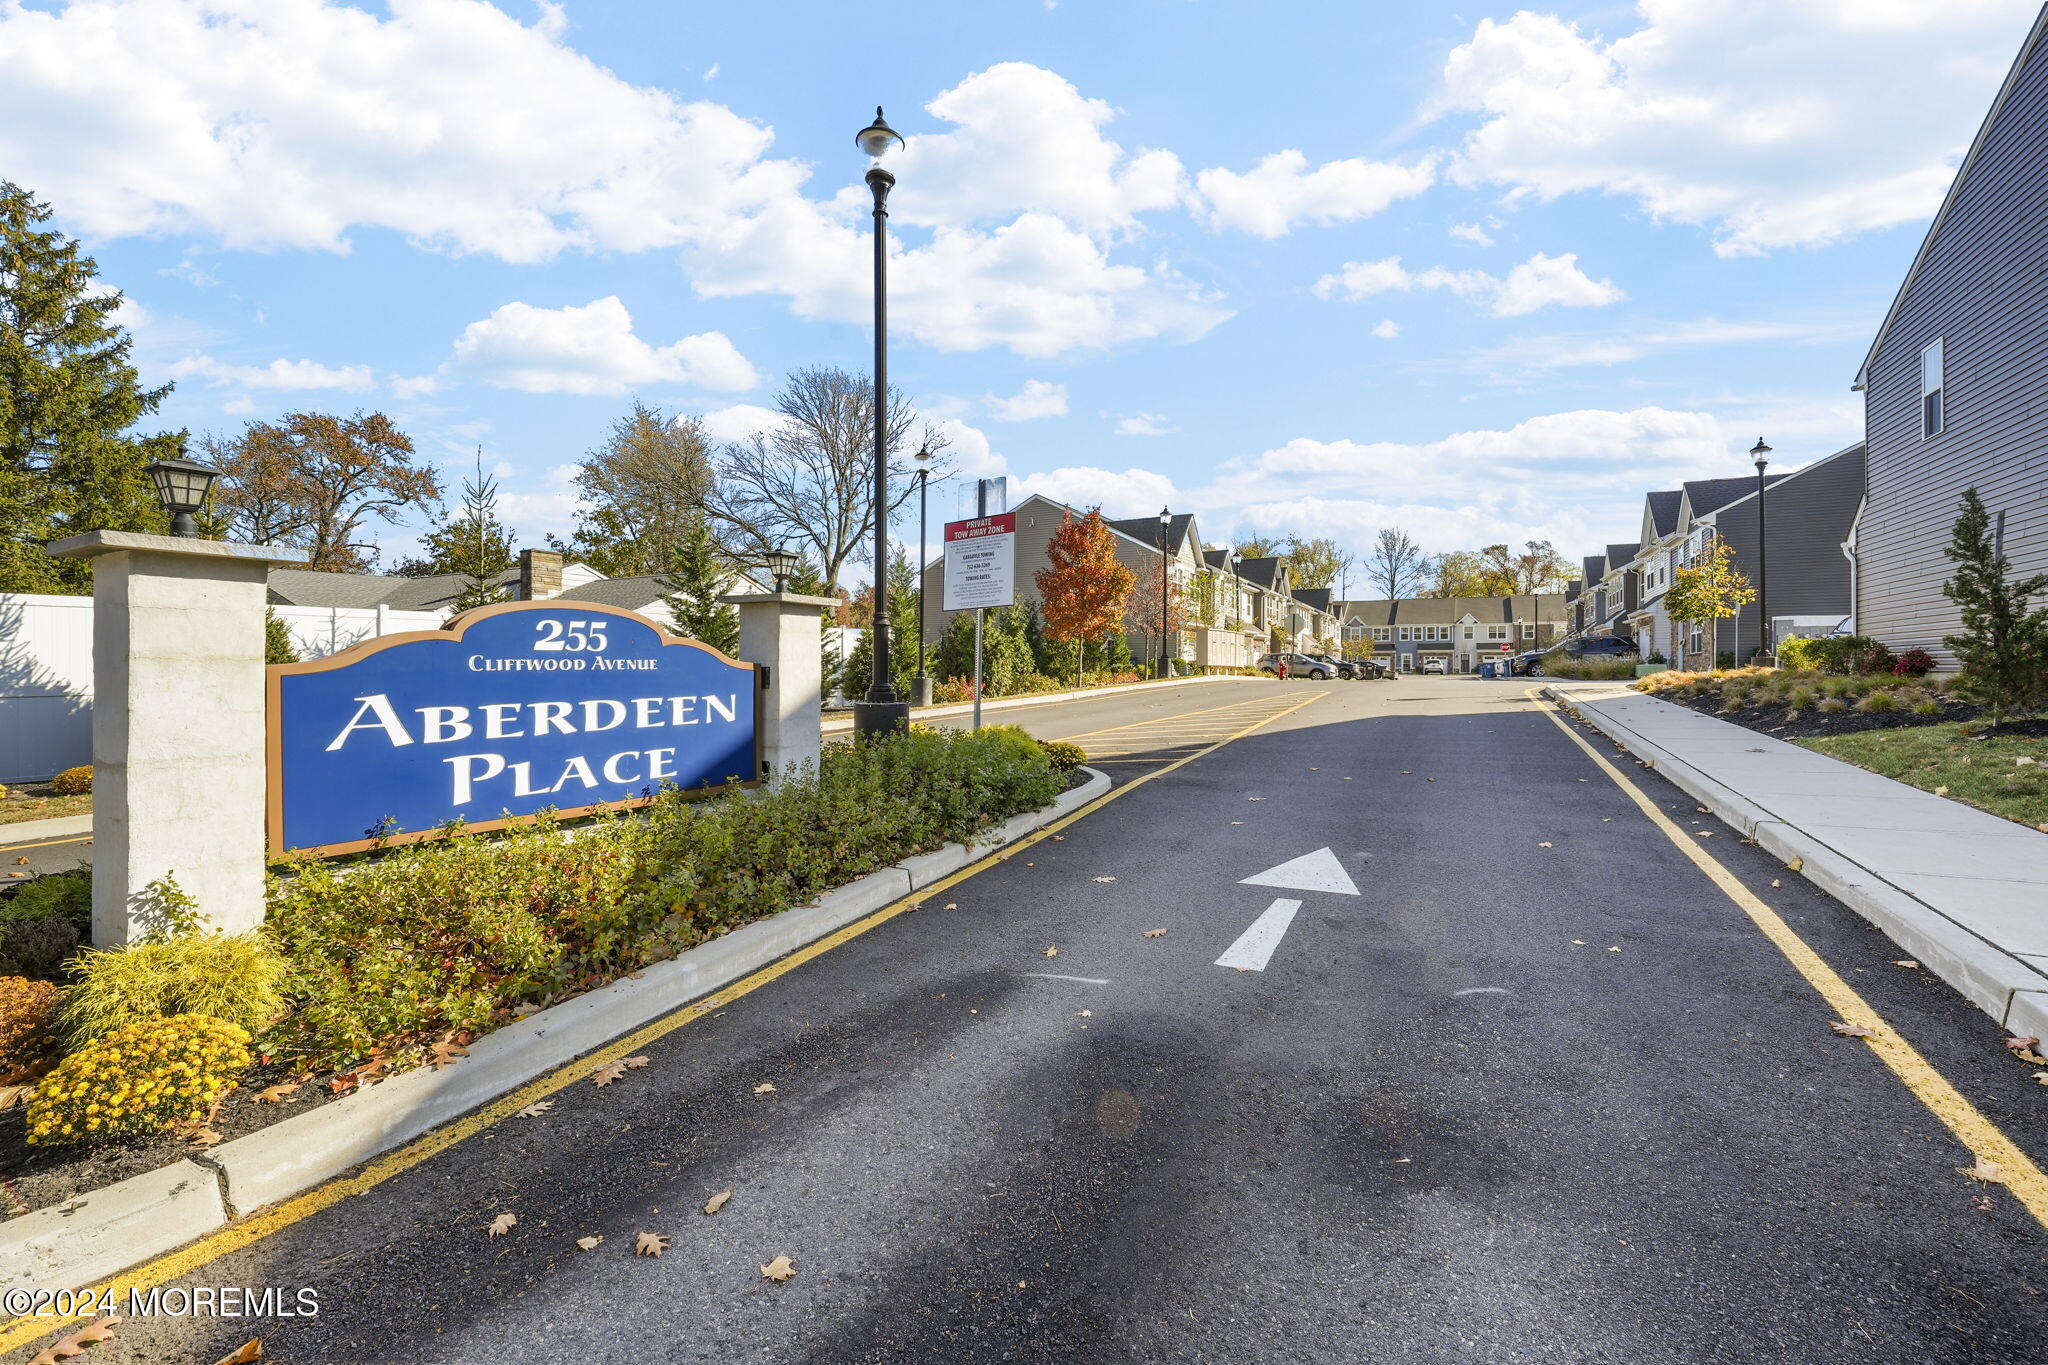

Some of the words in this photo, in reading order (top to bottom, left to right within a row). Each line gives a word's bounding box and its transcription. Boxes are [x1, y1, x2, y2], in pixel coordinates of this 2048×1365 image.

[954, 530, 969, 539] TOW
[969, 528, 987, 537] AWAY
[988, 525, 1005, 533] ZONE
[966, 518, 992, 528] PRIVATE
[965, 574, 979, 582] TOWING
[533, 619, 608, 653] 255
[468, 654, 587, 672] CLIFFWOOD
[591, 655, 659, 671] AVENUE
[324, 693, 738, 752] ABERDEEN
[442, 747, 678, 807] PLACE
